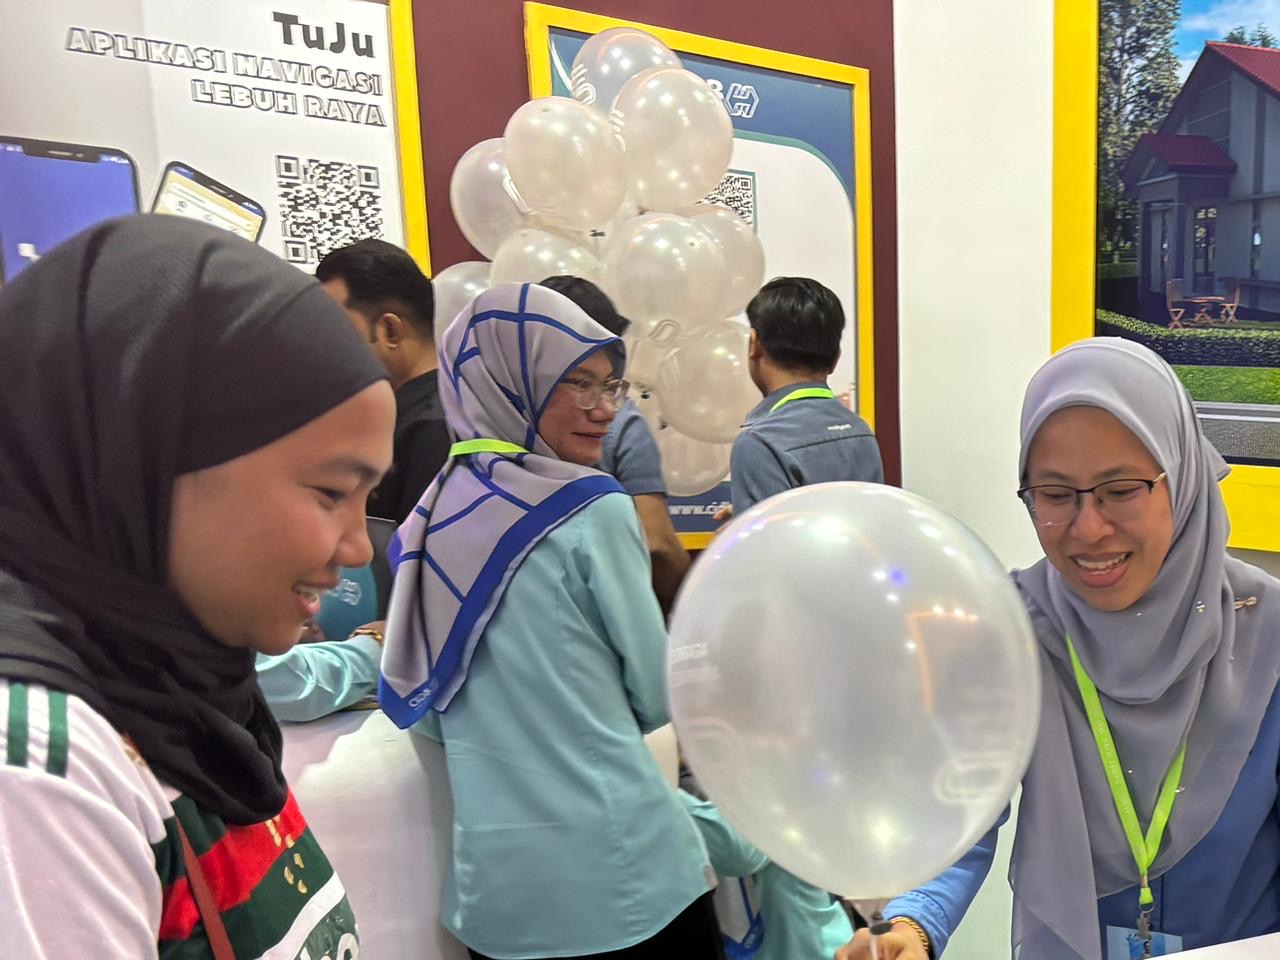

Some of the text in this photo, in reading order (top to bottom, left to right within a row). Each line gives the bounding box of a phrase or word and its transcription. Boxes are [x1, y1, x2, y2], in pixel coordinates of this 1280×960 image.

[271, 11, 376, 58] TuJu
[66, 27, 384, 96] APLIKASI NAVIGASI
[191, 78, 387, 127] LEBUH RAYA
